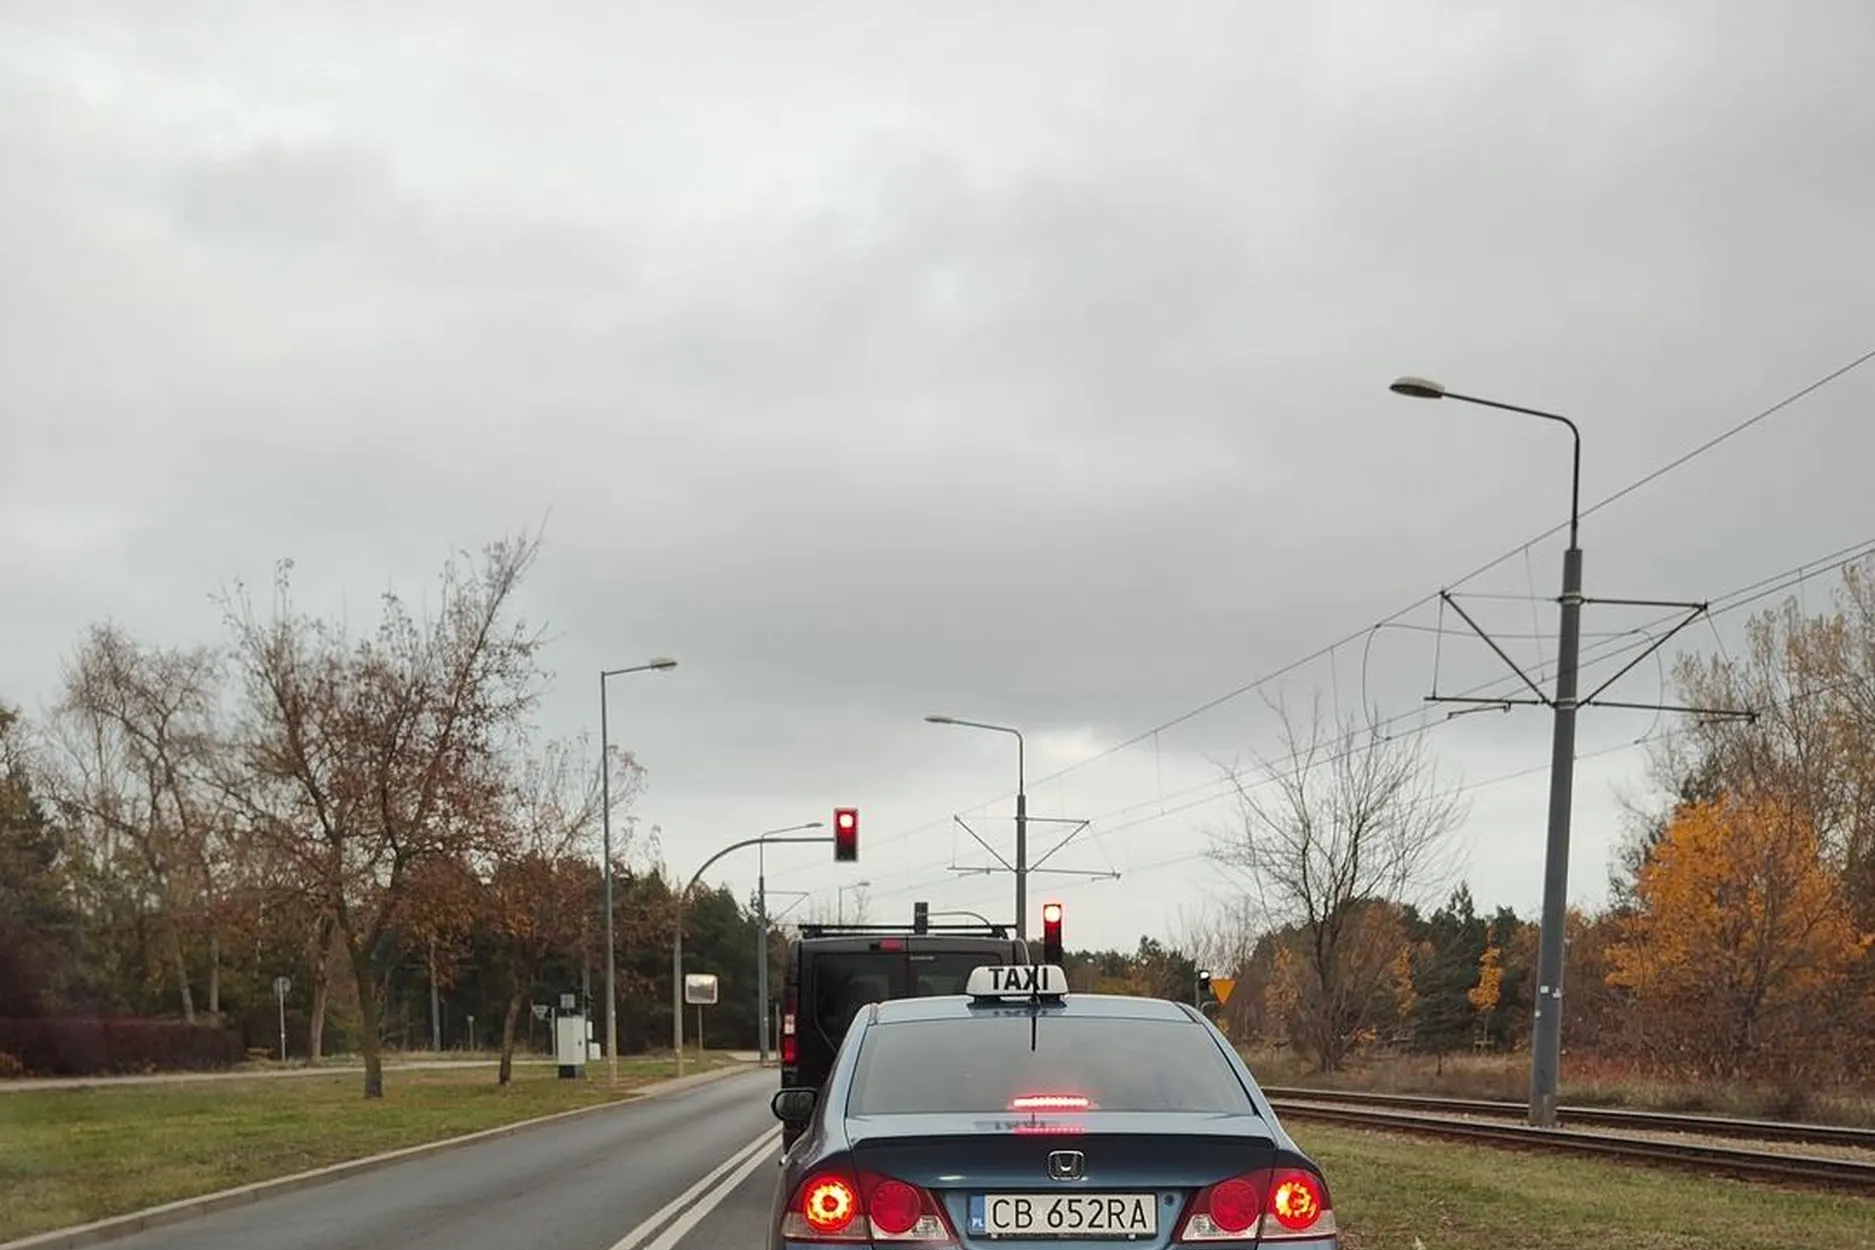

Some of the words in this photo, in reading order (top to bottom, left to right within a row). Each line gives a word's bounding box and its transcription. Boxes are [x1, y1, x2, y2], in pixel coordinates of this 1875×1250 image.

[988, 967, 1048, 990] TAXI
[992, 1198, 1033, 1229] CB
[1047, 1198, 1147, 1229] 652RA
